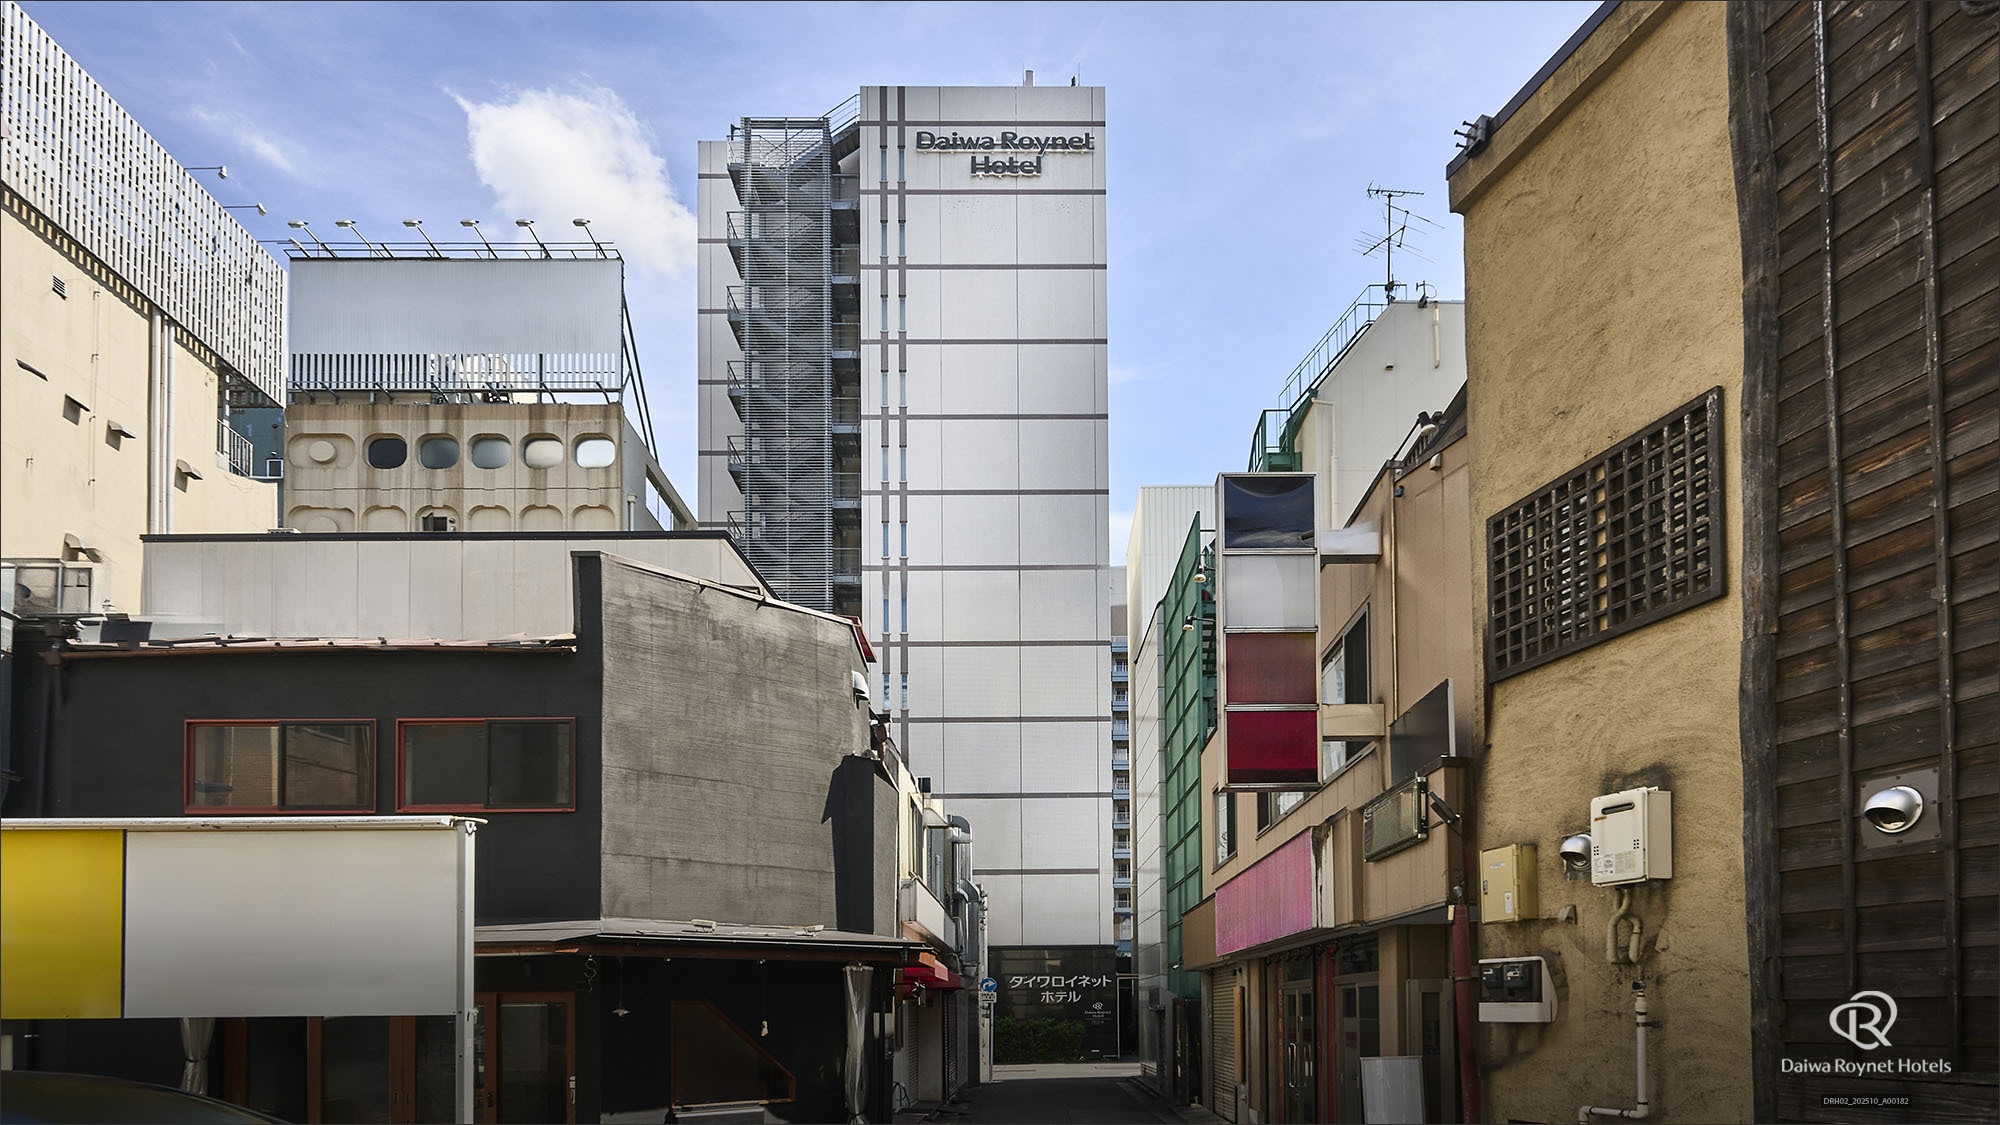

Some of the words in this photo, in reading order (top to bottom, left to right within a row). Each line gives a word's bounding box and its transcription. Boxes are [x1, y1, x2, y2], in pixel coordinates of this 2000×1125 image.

[916, 131, 995, 150] Daiwa
[1001, 131, 1095, 155] Roynet
[970, 155, 1042, 175] Hotel
[1009, 974, 1112, 989] ダイワロイネット
[1040, 990, 1082, 1004] ホテル
